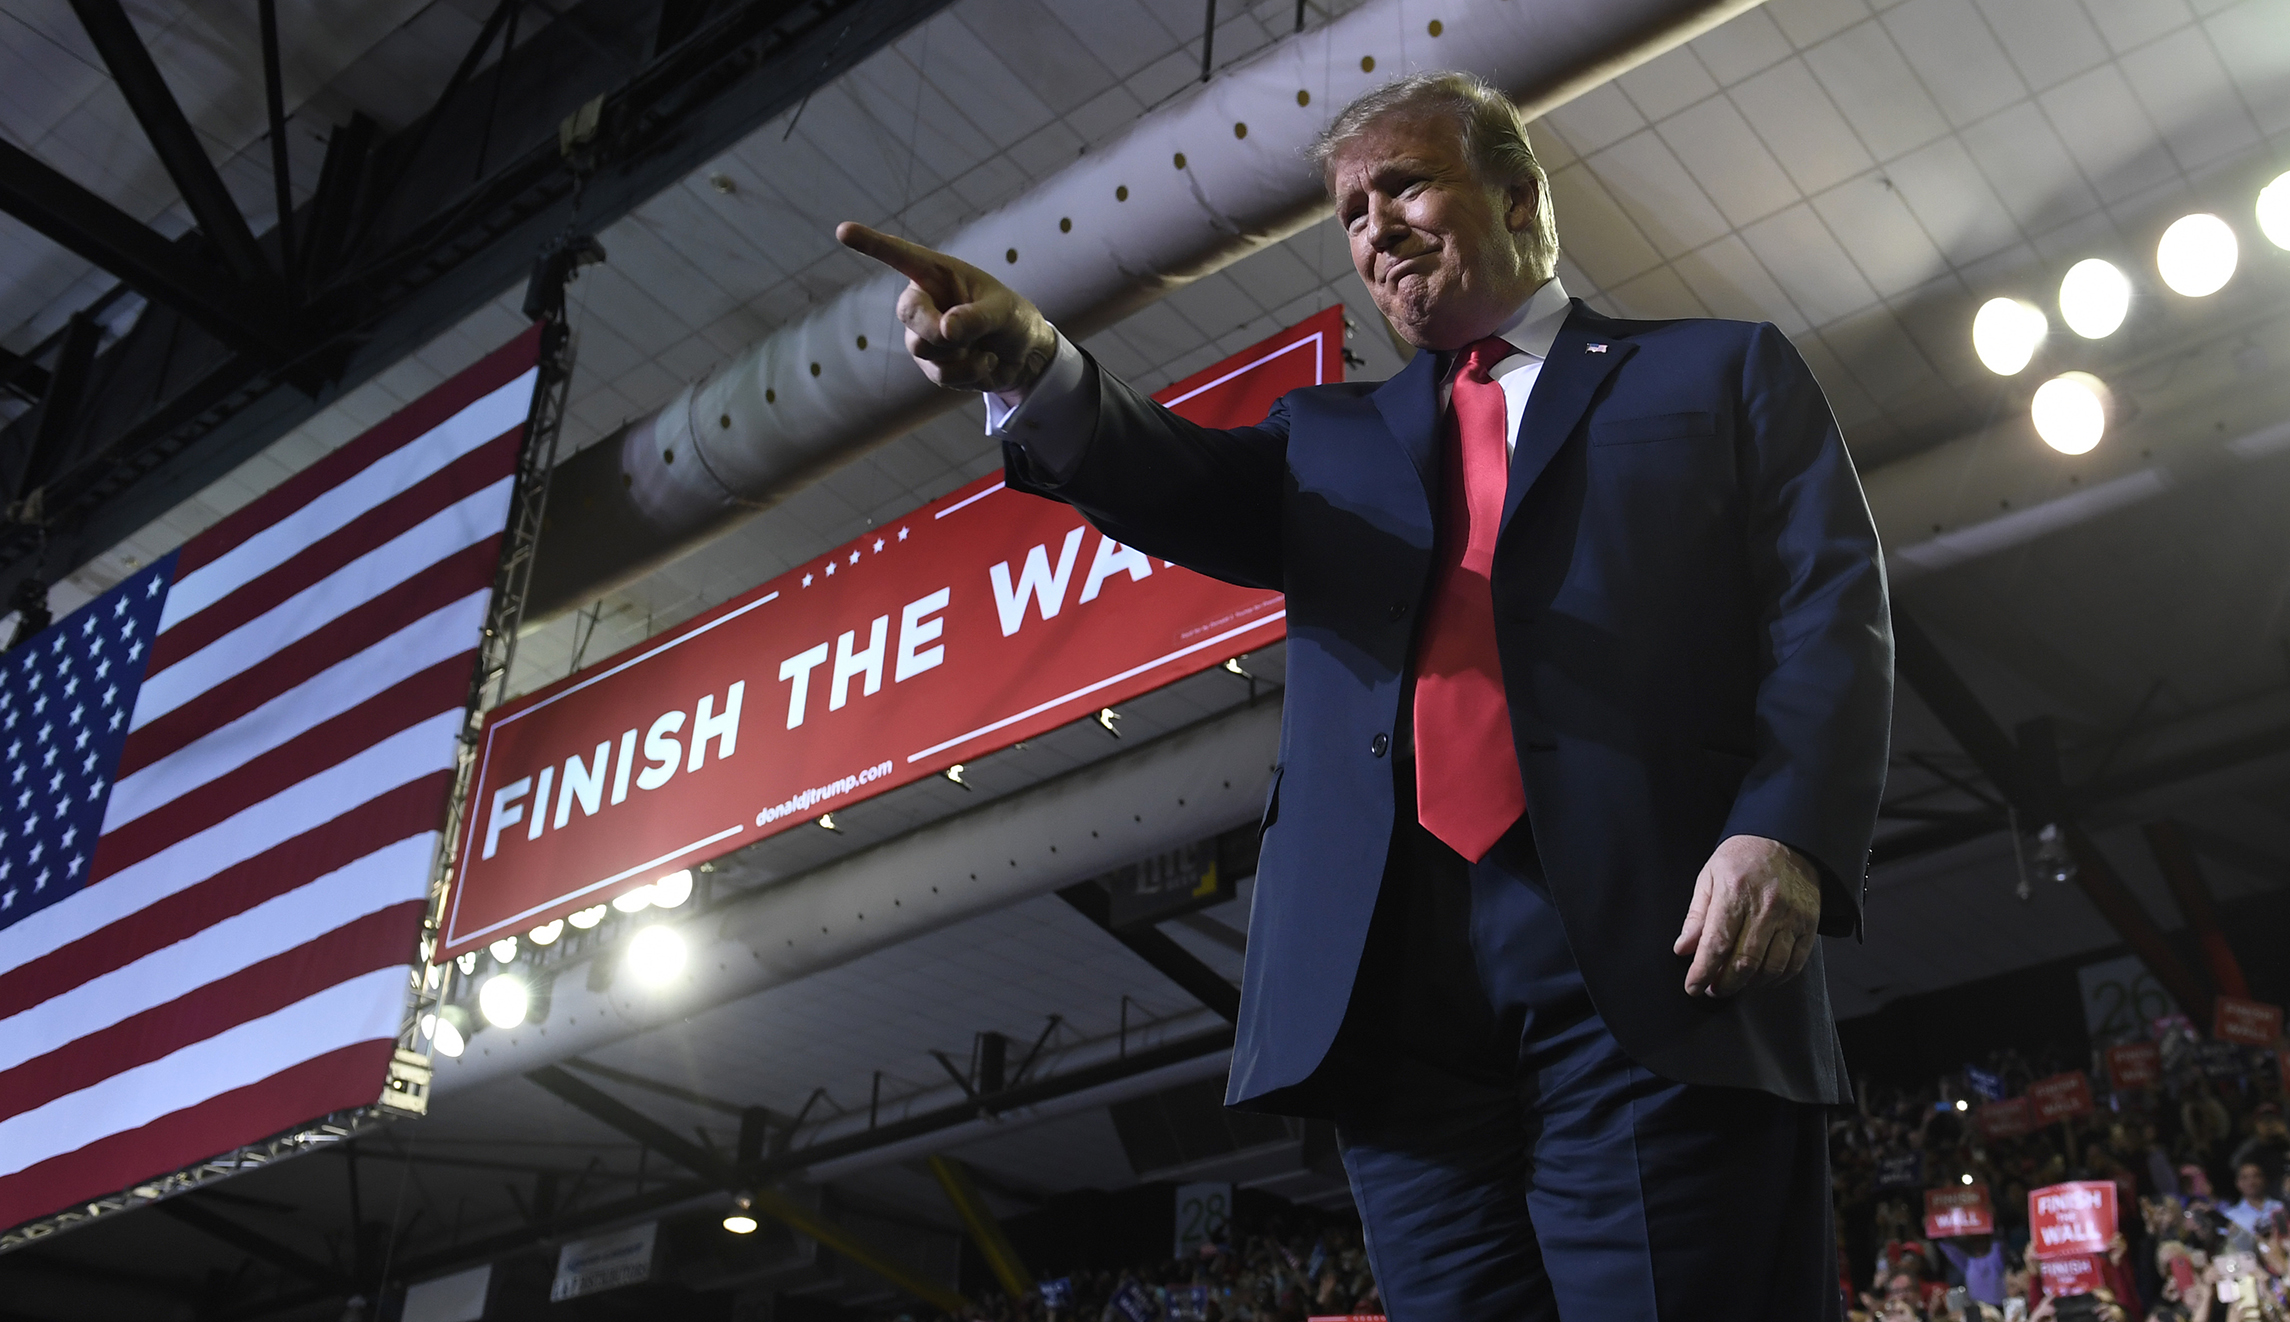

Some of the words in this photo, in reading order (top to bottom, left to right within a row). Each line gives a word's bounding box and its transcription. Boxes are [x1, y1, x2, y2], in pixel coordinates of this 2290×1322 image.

[482, 680, 745, 861] FINISH
[778, 587, 950, 731] THE
[989, 525, 1176, 638] WA
[756, 760, 893, 827] donaldjtrump.com
[2093, 974, 2169, 1035] 26
[1183, 1192, 1226, 1241] 28
[1935, 1210, 1981, 1229] WALL
[2037, 1190, 2103, 1216] FINISH
[2040, 1220, 2103, 1246] WALL
